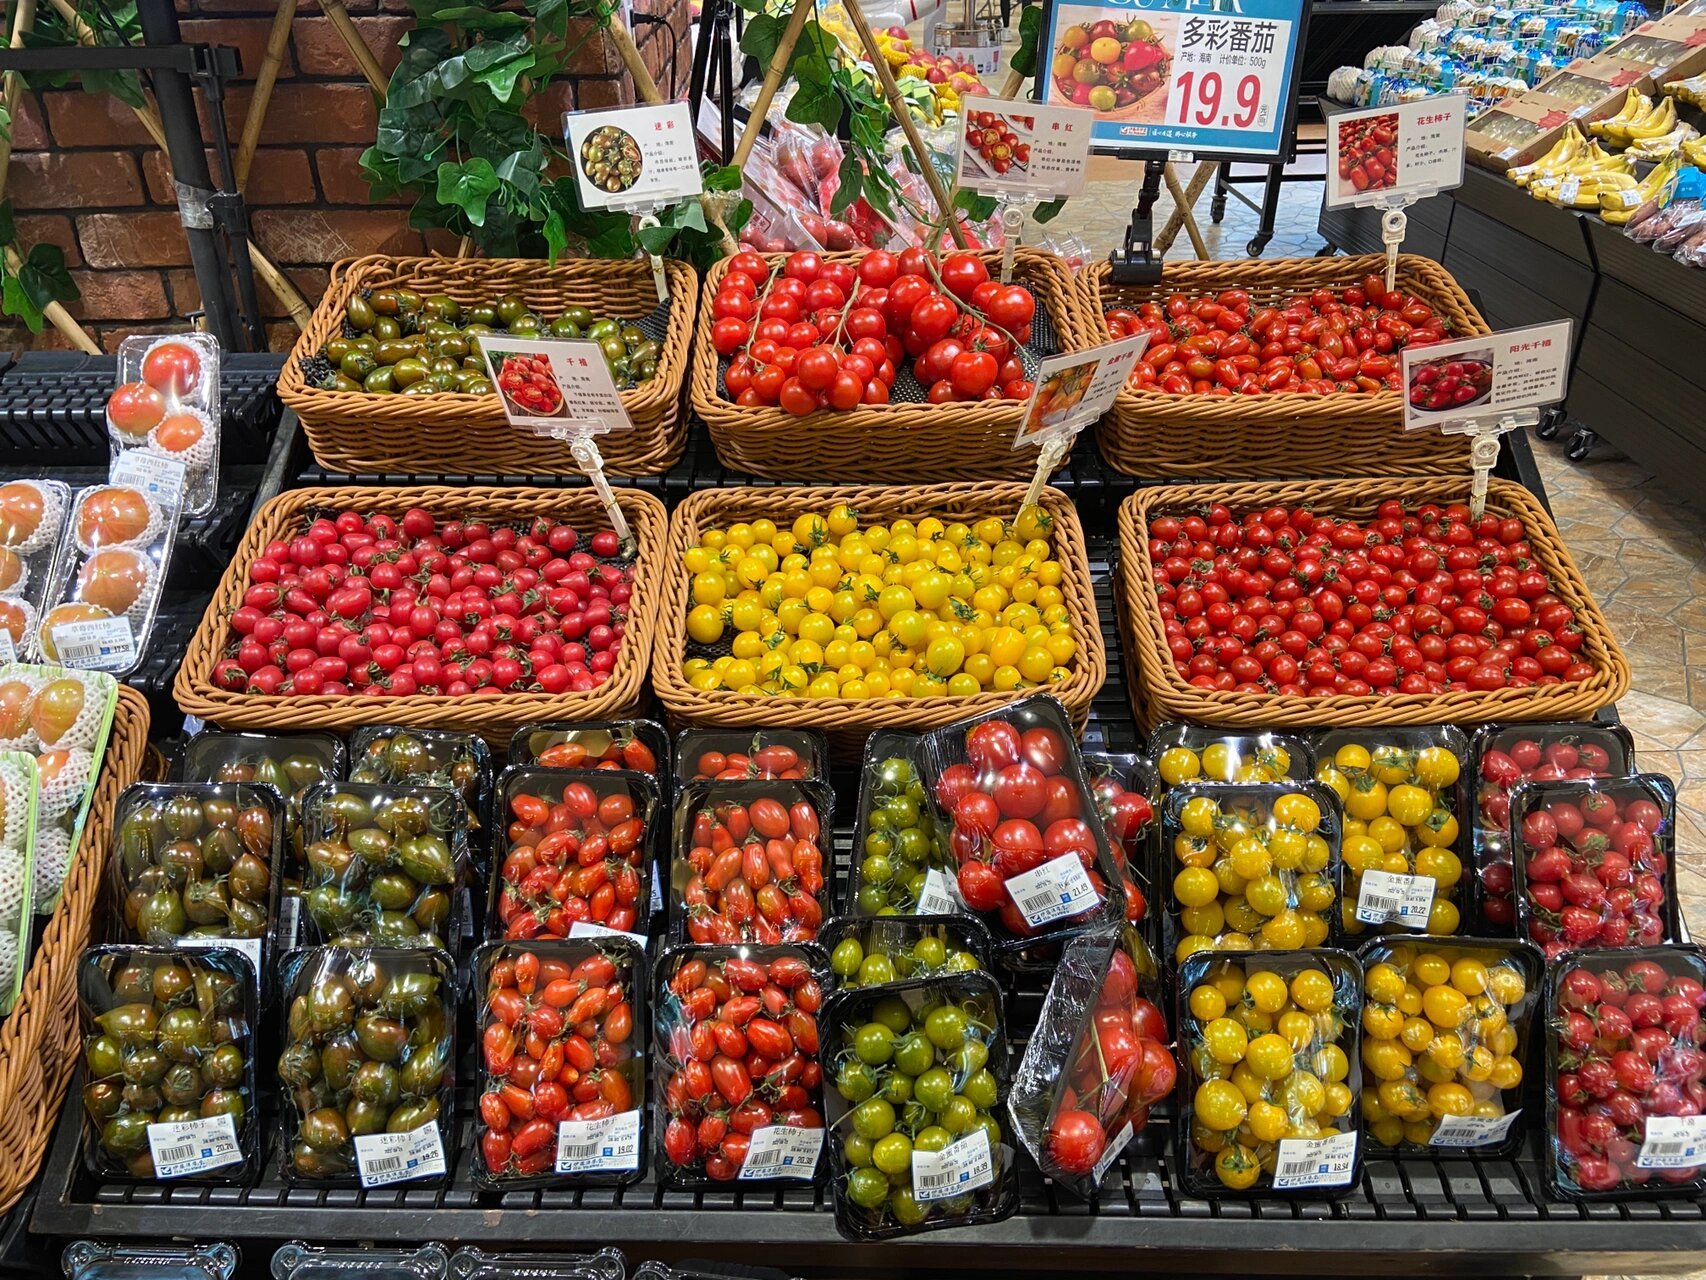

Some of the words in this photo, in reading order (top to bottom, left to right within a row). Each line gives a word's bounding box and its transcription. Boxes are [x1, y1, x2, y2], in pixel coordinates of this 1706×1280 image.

[1181, 16, 1278, 54] 多彩番茄
[1176, 71, 1261, 128] 19.9
[1416, 112, 1452, 126] 花生柿子
[654, 120, 675, 131] 迷彩
[1051, 122, 1074, 132] 串红
[1509, 339, 1552, 354] 阳光千禧
[566, 357, 588, 368] 千禧
[774, 1128, 805, 1136] 花生柿子
[216, 1143, 234, 1152] 20.70
[618, 1145, 634, 1154] 19.02
